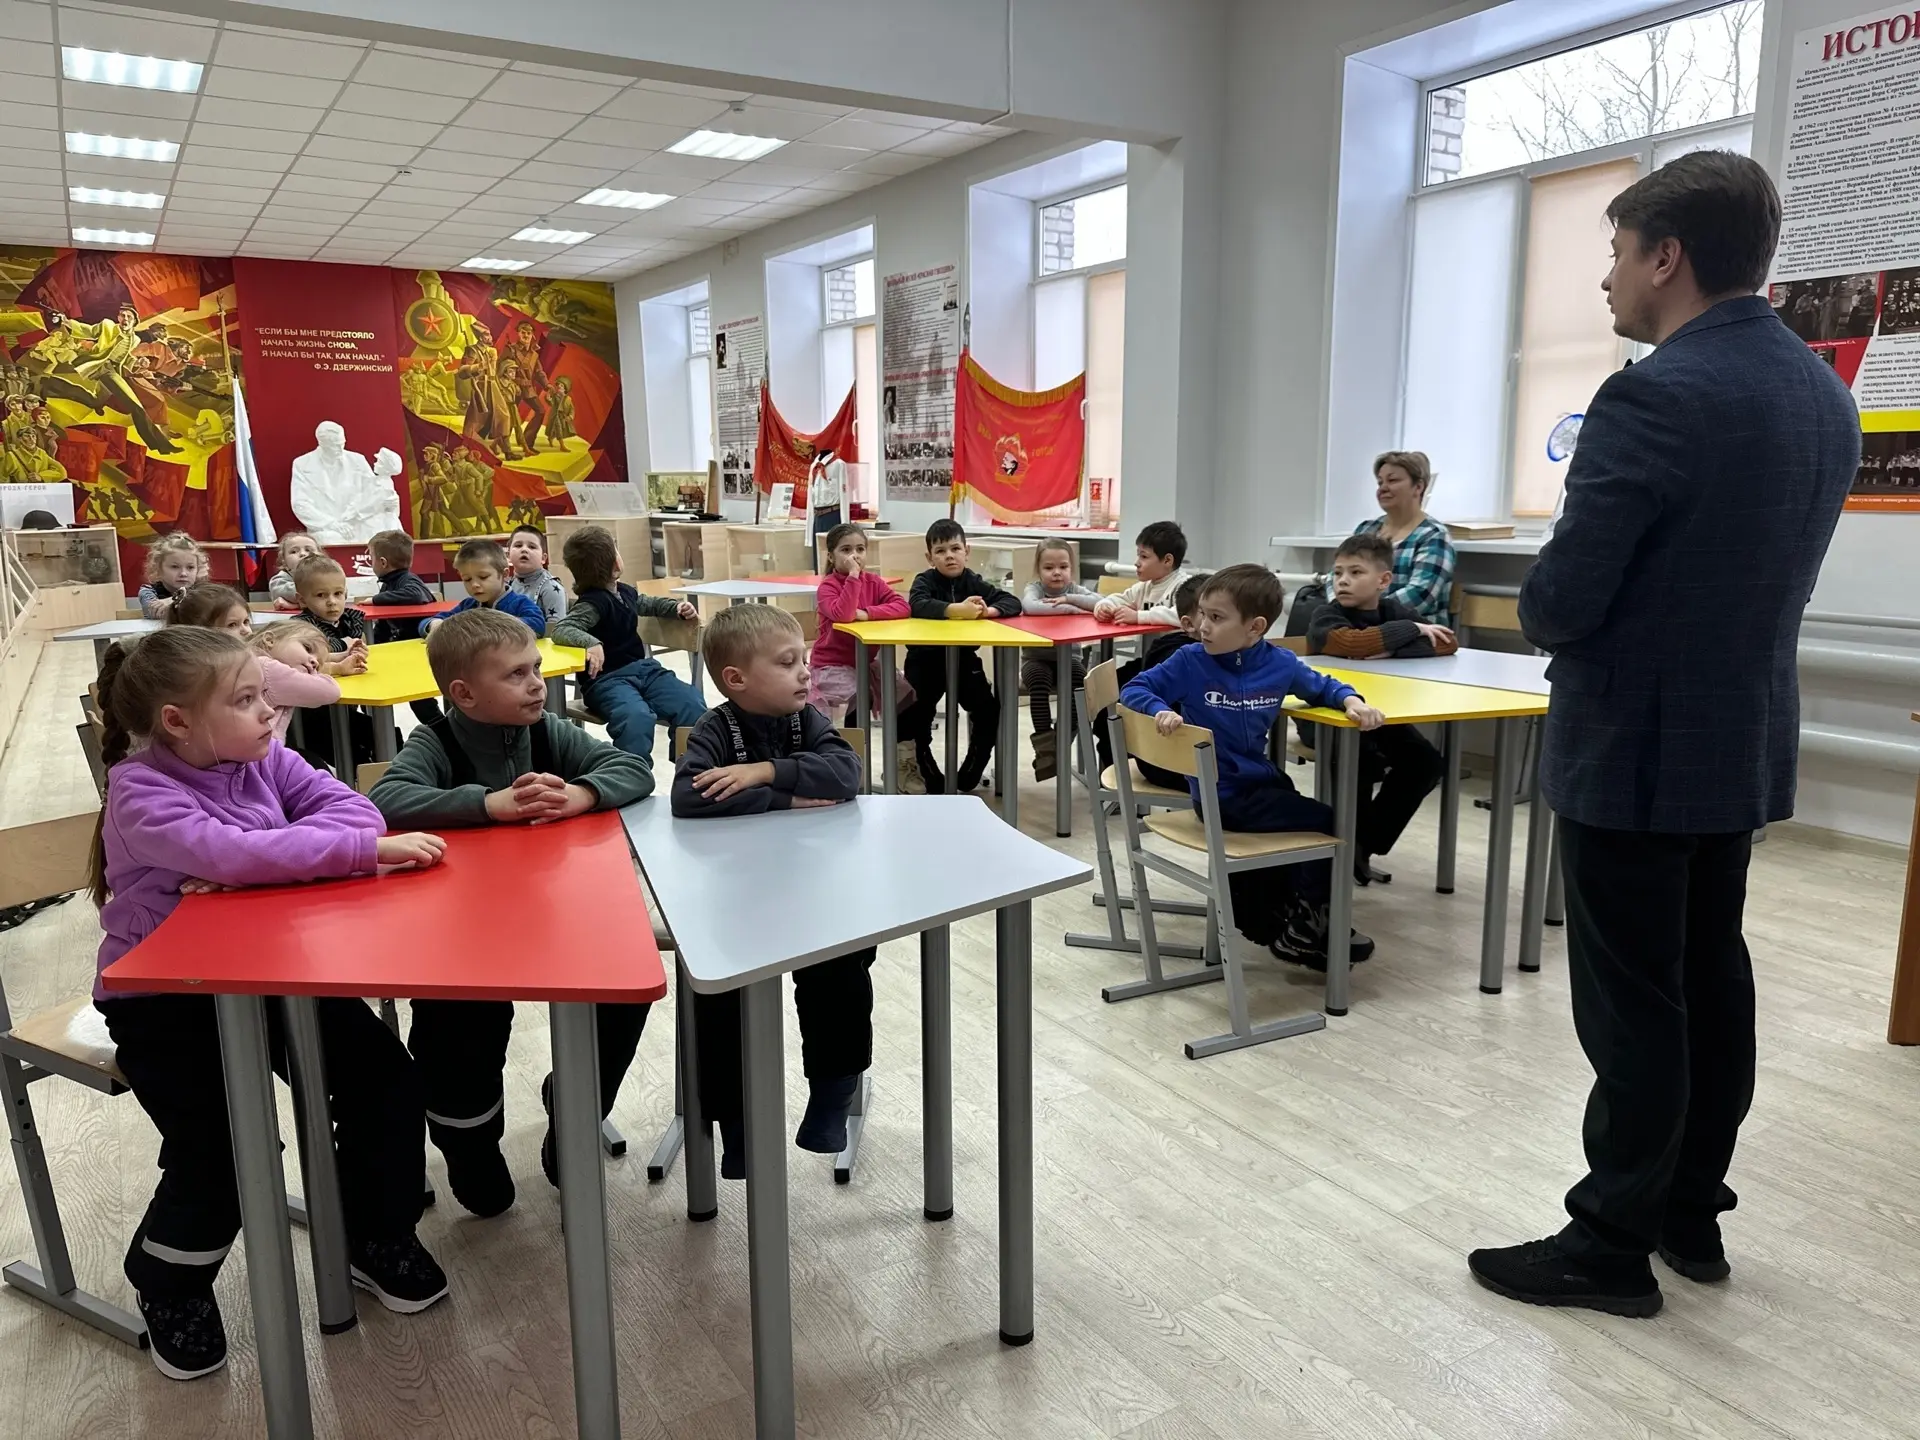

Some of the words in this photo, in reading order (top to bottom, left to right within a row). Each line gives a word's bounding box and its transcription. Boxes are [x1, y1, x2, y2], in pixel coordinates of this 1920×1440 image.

[320, 331, 375, 339] ПРЕДСТОЯЛО
[327, 342, 358, 350] СНОВА,
[333, 364, 393, 372] ДЗЕРЖИНСКИЙ
[1204, 691, 1279, 710] Champion
